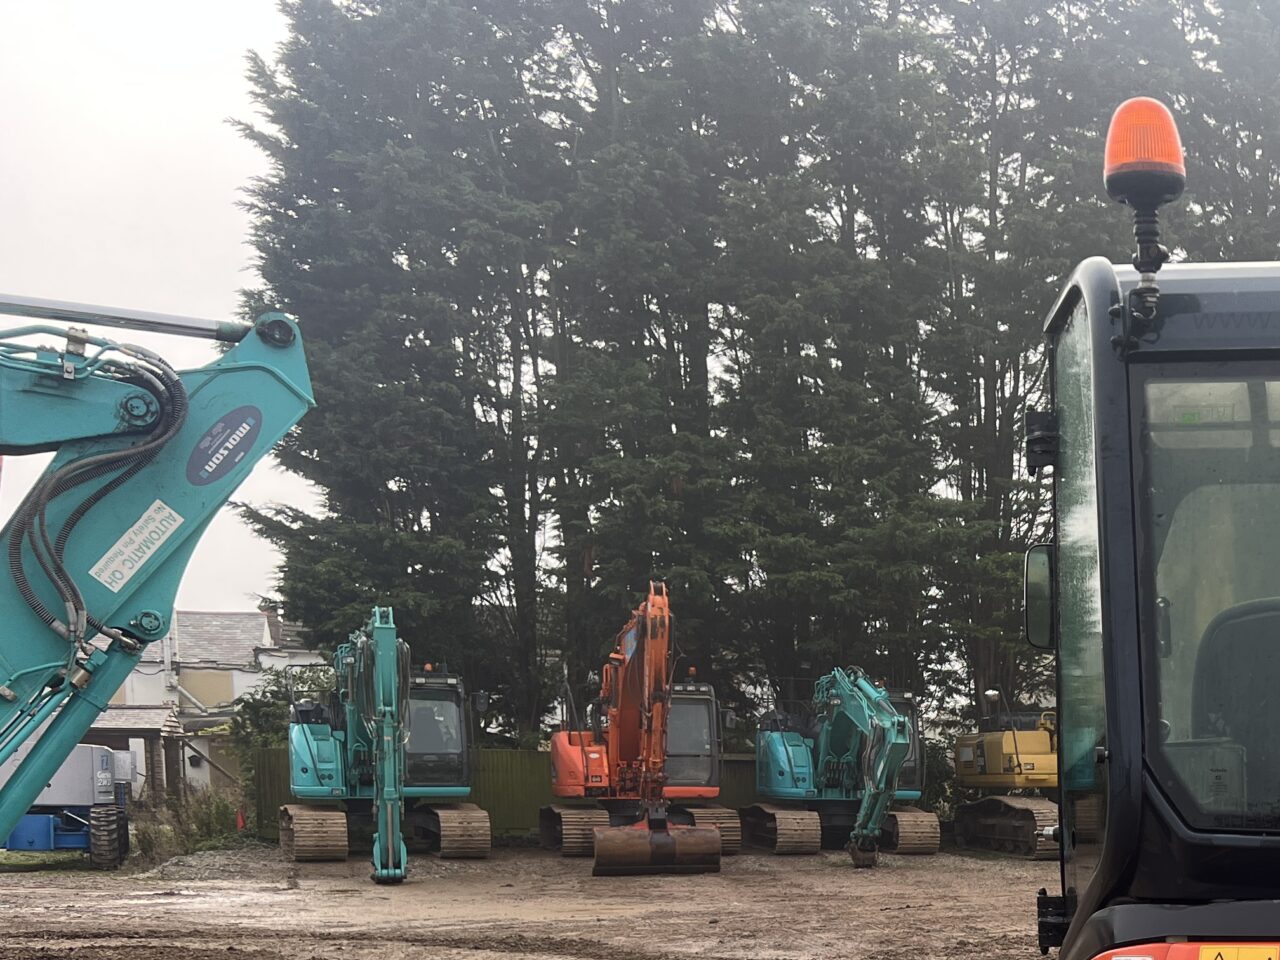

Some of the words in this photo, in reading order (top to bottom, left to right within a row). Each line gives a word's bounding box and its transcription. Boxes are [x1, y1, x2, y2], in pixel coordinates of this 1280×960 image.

[153, 504, 167, 514] No
[132, 515, 156, 537] Safety
[122, 511, 177, 570] AUTOMATIC
[122, 537, 135, 548] Pin
[94, 548, 125, 577] Required
